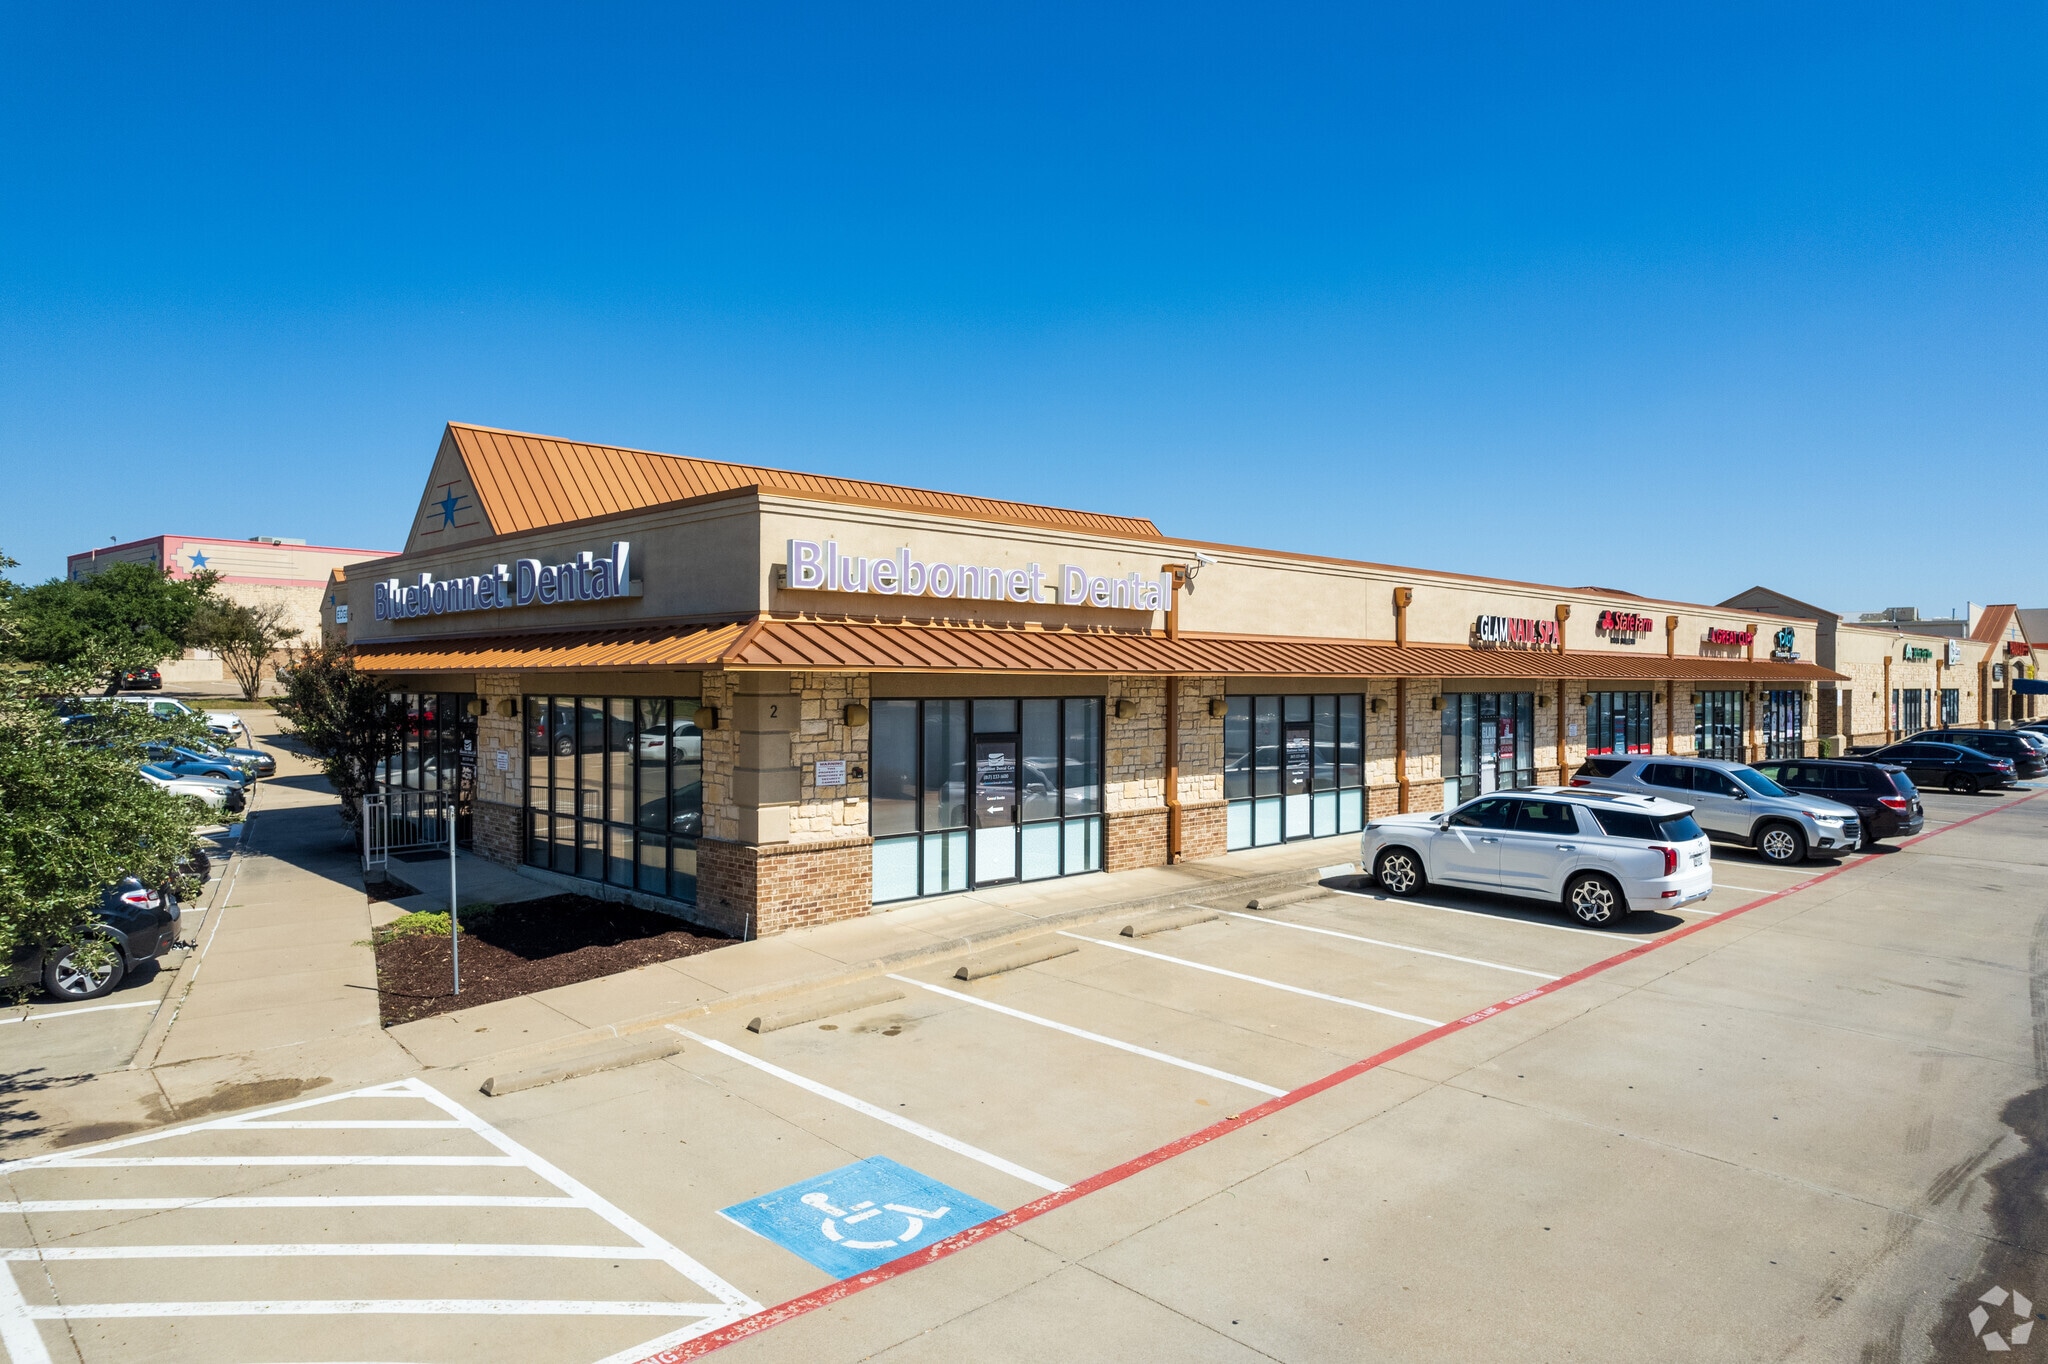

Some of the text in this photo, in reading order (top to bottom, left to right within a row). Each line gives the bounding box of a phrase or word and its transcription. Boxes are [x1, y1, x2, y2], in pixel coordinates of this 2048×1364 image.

[374, 541, 630, 621] Bluebonnet Dental
[787, 539, 1172, 612] Bluebonnet Dental
[1538, 619, 1561, 646] SPA
[1614, 611, 1653, 632] State Farm
[770, 704, 778, 719] 2
